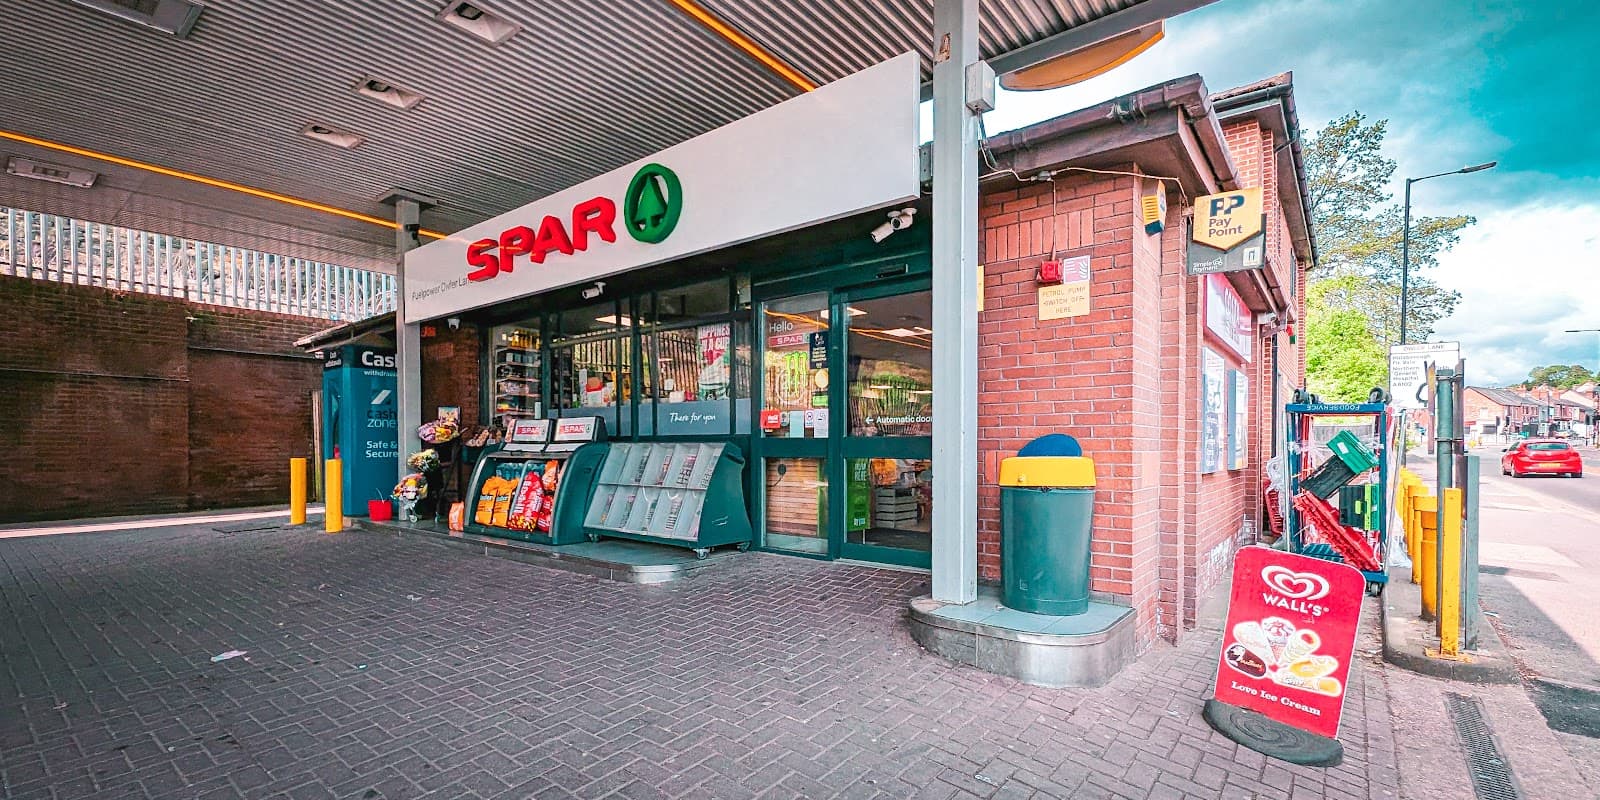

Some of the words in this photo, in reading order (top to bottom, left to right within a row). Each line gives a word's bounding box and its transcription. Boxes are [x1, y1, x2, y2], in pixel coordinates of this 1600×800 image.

[1209, 217, 1232, 228] Pay
[1209, 225, 1243, 237] Point
[467, 196, 616, 282] SPAR
[769, 320, 794, 334] Hello
[776, 336, 804, 346] SPAR
[670, 412, 690, 423] There
[690, 412, 702, 424] for
[702, 413, 716, 424] you
[876, 415, 915, 424] Automatic
[915, 414, 933, 423] doo
[563, 424, 585, 433] SPAR
[366, 440, 389, 449] Safe
[365, 449, 398, 458] Secure
[1262, 592, 1322, 617] WALL'S
[1231, 681, 1258, 696] Love
[1260, 689, 1278, 703] Ice
[1280, 696, 1321, 716] Cream
